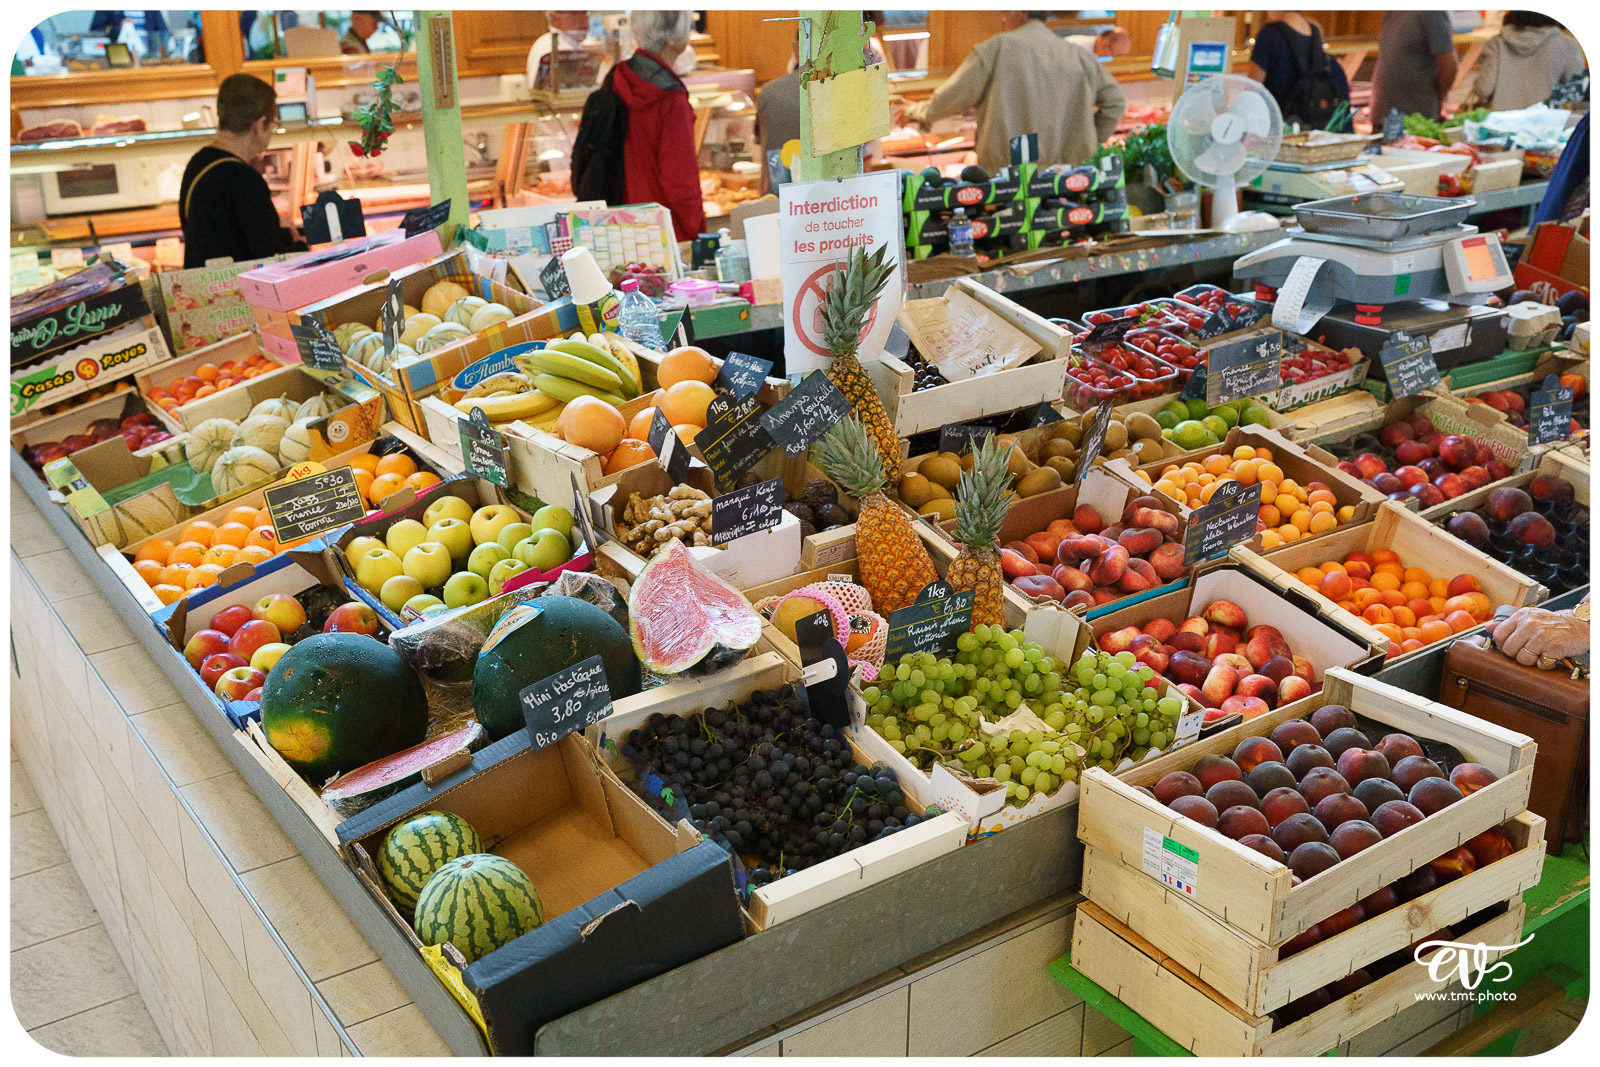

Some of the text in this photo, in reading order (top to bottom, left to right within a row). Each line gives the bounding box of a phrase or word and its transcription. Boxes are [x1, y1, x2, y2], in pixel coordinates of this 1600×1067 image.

[957, 187, 983, 203] TROPS
[789, 194, 878, 216] Interdiction
[805, 217, 864, 232] de toucher
[1069, 209, 1093, 225] TROPS
[794, 233, 874, 253] les produits
[63, 301, 121, 336] Luna
[100, 343, 146, 370] Royes
[1221, 364, 1253, 379] France
[21, 371, 75, 399] Casas
[710, 400, 728, 415] 1kg
[1491, 439, 1519, 463] FRUIT
[290, 465, 312, 481] 1kg
[1222, 483, 1238, 496] 1kg
[285, 505, 328, 523] France
[298, 516, 335, 534] Pomme
[713, 524, 746, 542] Mexique
[1202, 540, 1224, 553] France
[927, 583, 946, 598] 1kg
[551, 698, 582, 724] 3,80
[535, 732, 558, 748] Bio
